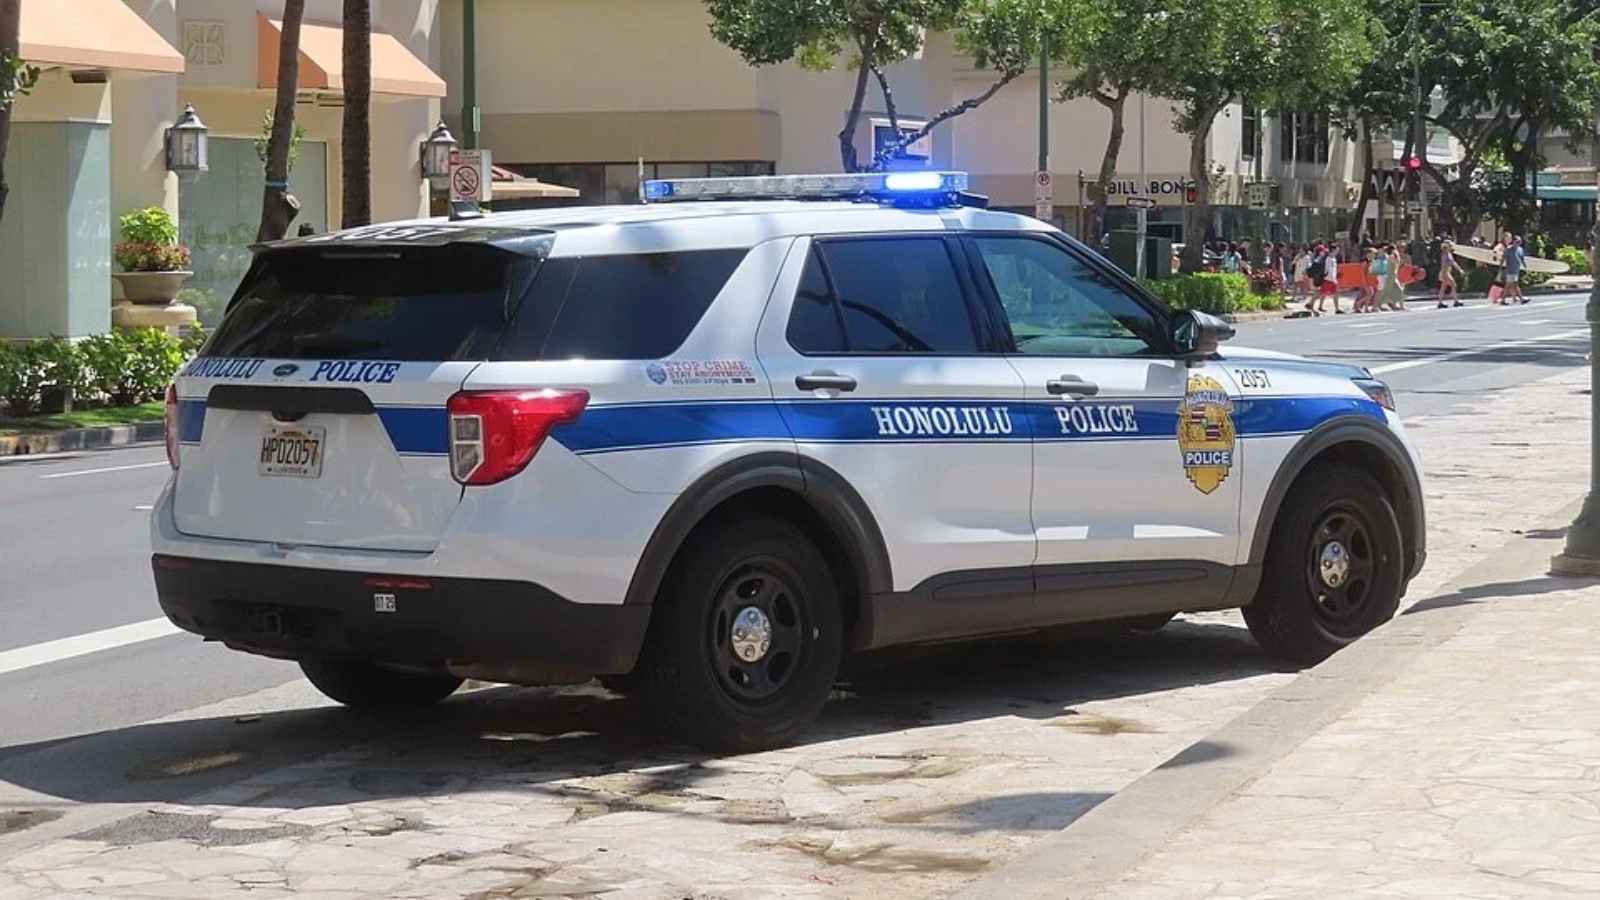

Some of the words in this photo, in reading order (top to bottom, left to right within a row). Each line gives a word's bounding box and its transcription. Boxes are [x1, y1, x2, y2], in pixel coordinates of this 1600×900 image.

[310, 361, 400, 384] POLICE
[666, 360, 701, 371] STOP
[1235, 369, 1272, 388] 2057
[871, 406, 1013, 435] HONOLULU
[1054, 404, 1138, 433] POLICE
[260, 437, 319, 467] HPD2057
[1186, 452, 1230, 465] POLICE
